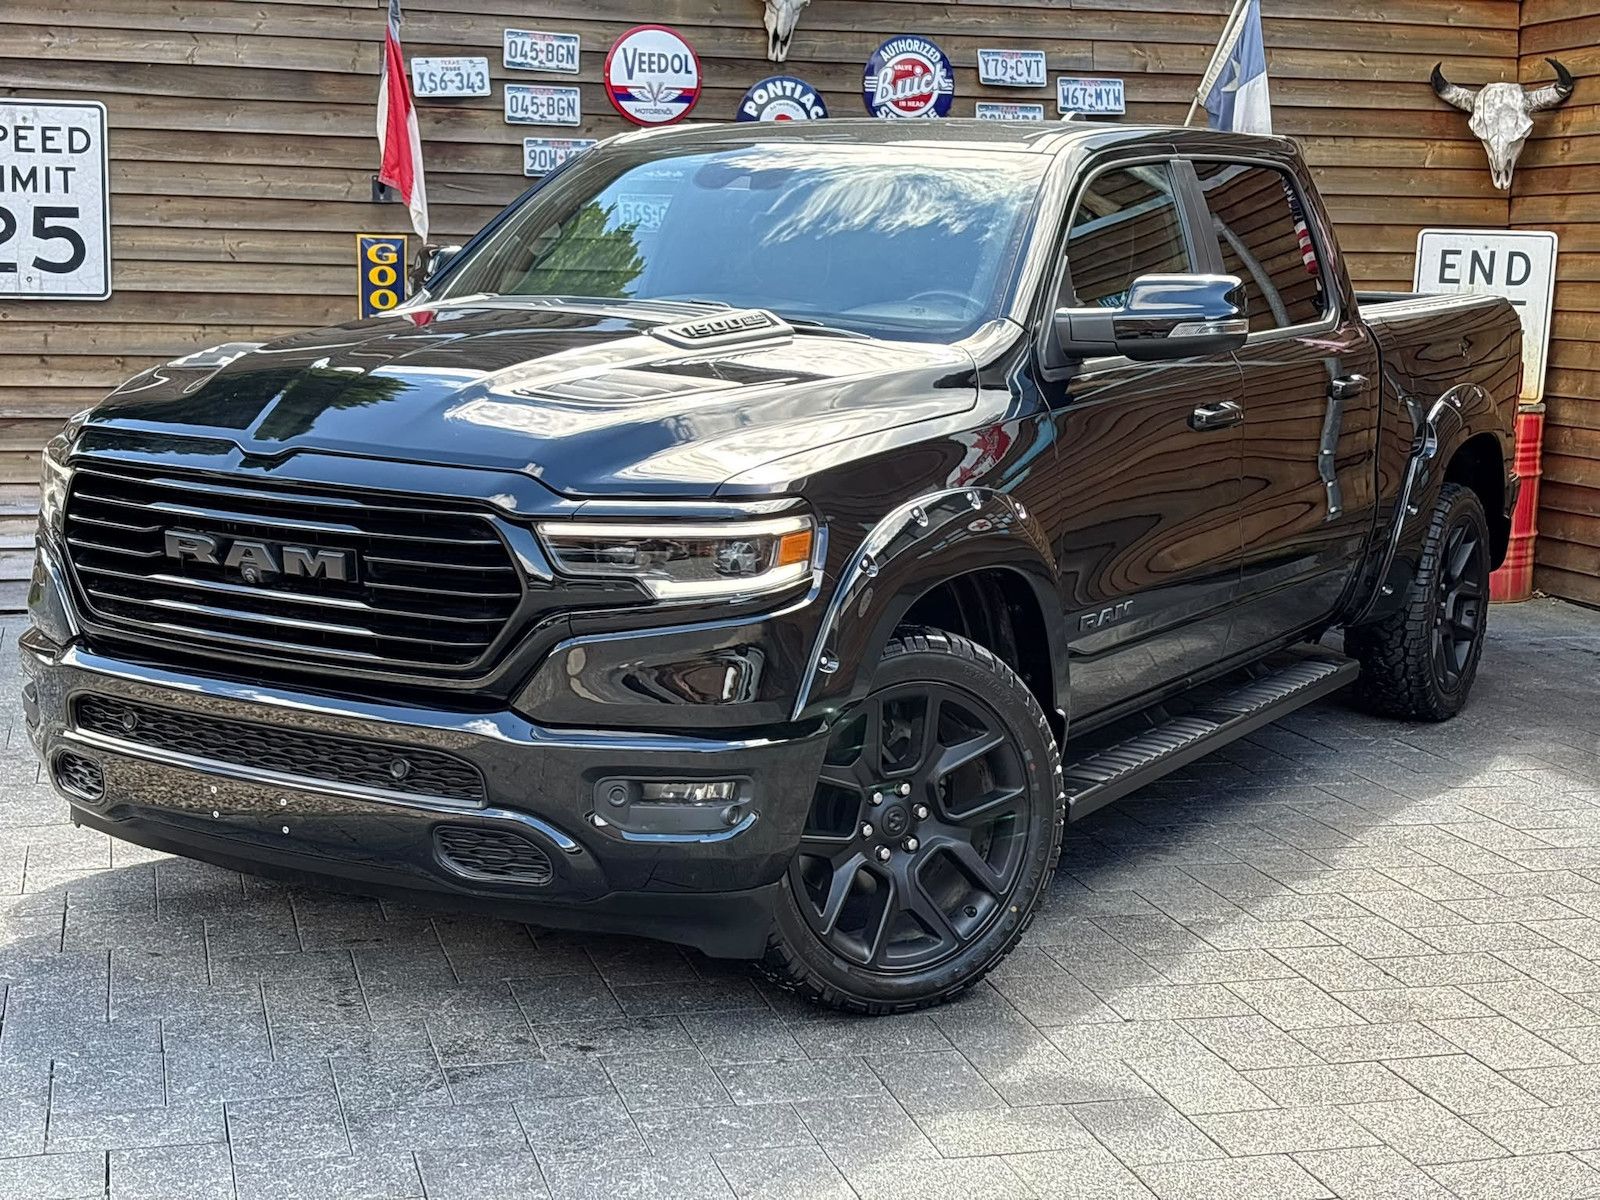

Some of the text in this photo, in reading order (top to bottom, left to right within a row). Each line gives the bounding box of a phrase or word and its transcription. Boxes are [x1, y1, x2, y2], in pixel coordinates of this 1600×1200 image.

[622, 48, 692, 80] VEEDOL
[880, 39, 941, 63] AUTHORIZED
[743, 80, 824, 120] PONTIAC
[872, 61, 949, 107] Buick
[1438, 249, 1531, 286] END
[681, 317, 743, 337] 1500
[164, 529, 348, 582] RAM
[1078, 600, 1135, 632] RAM
